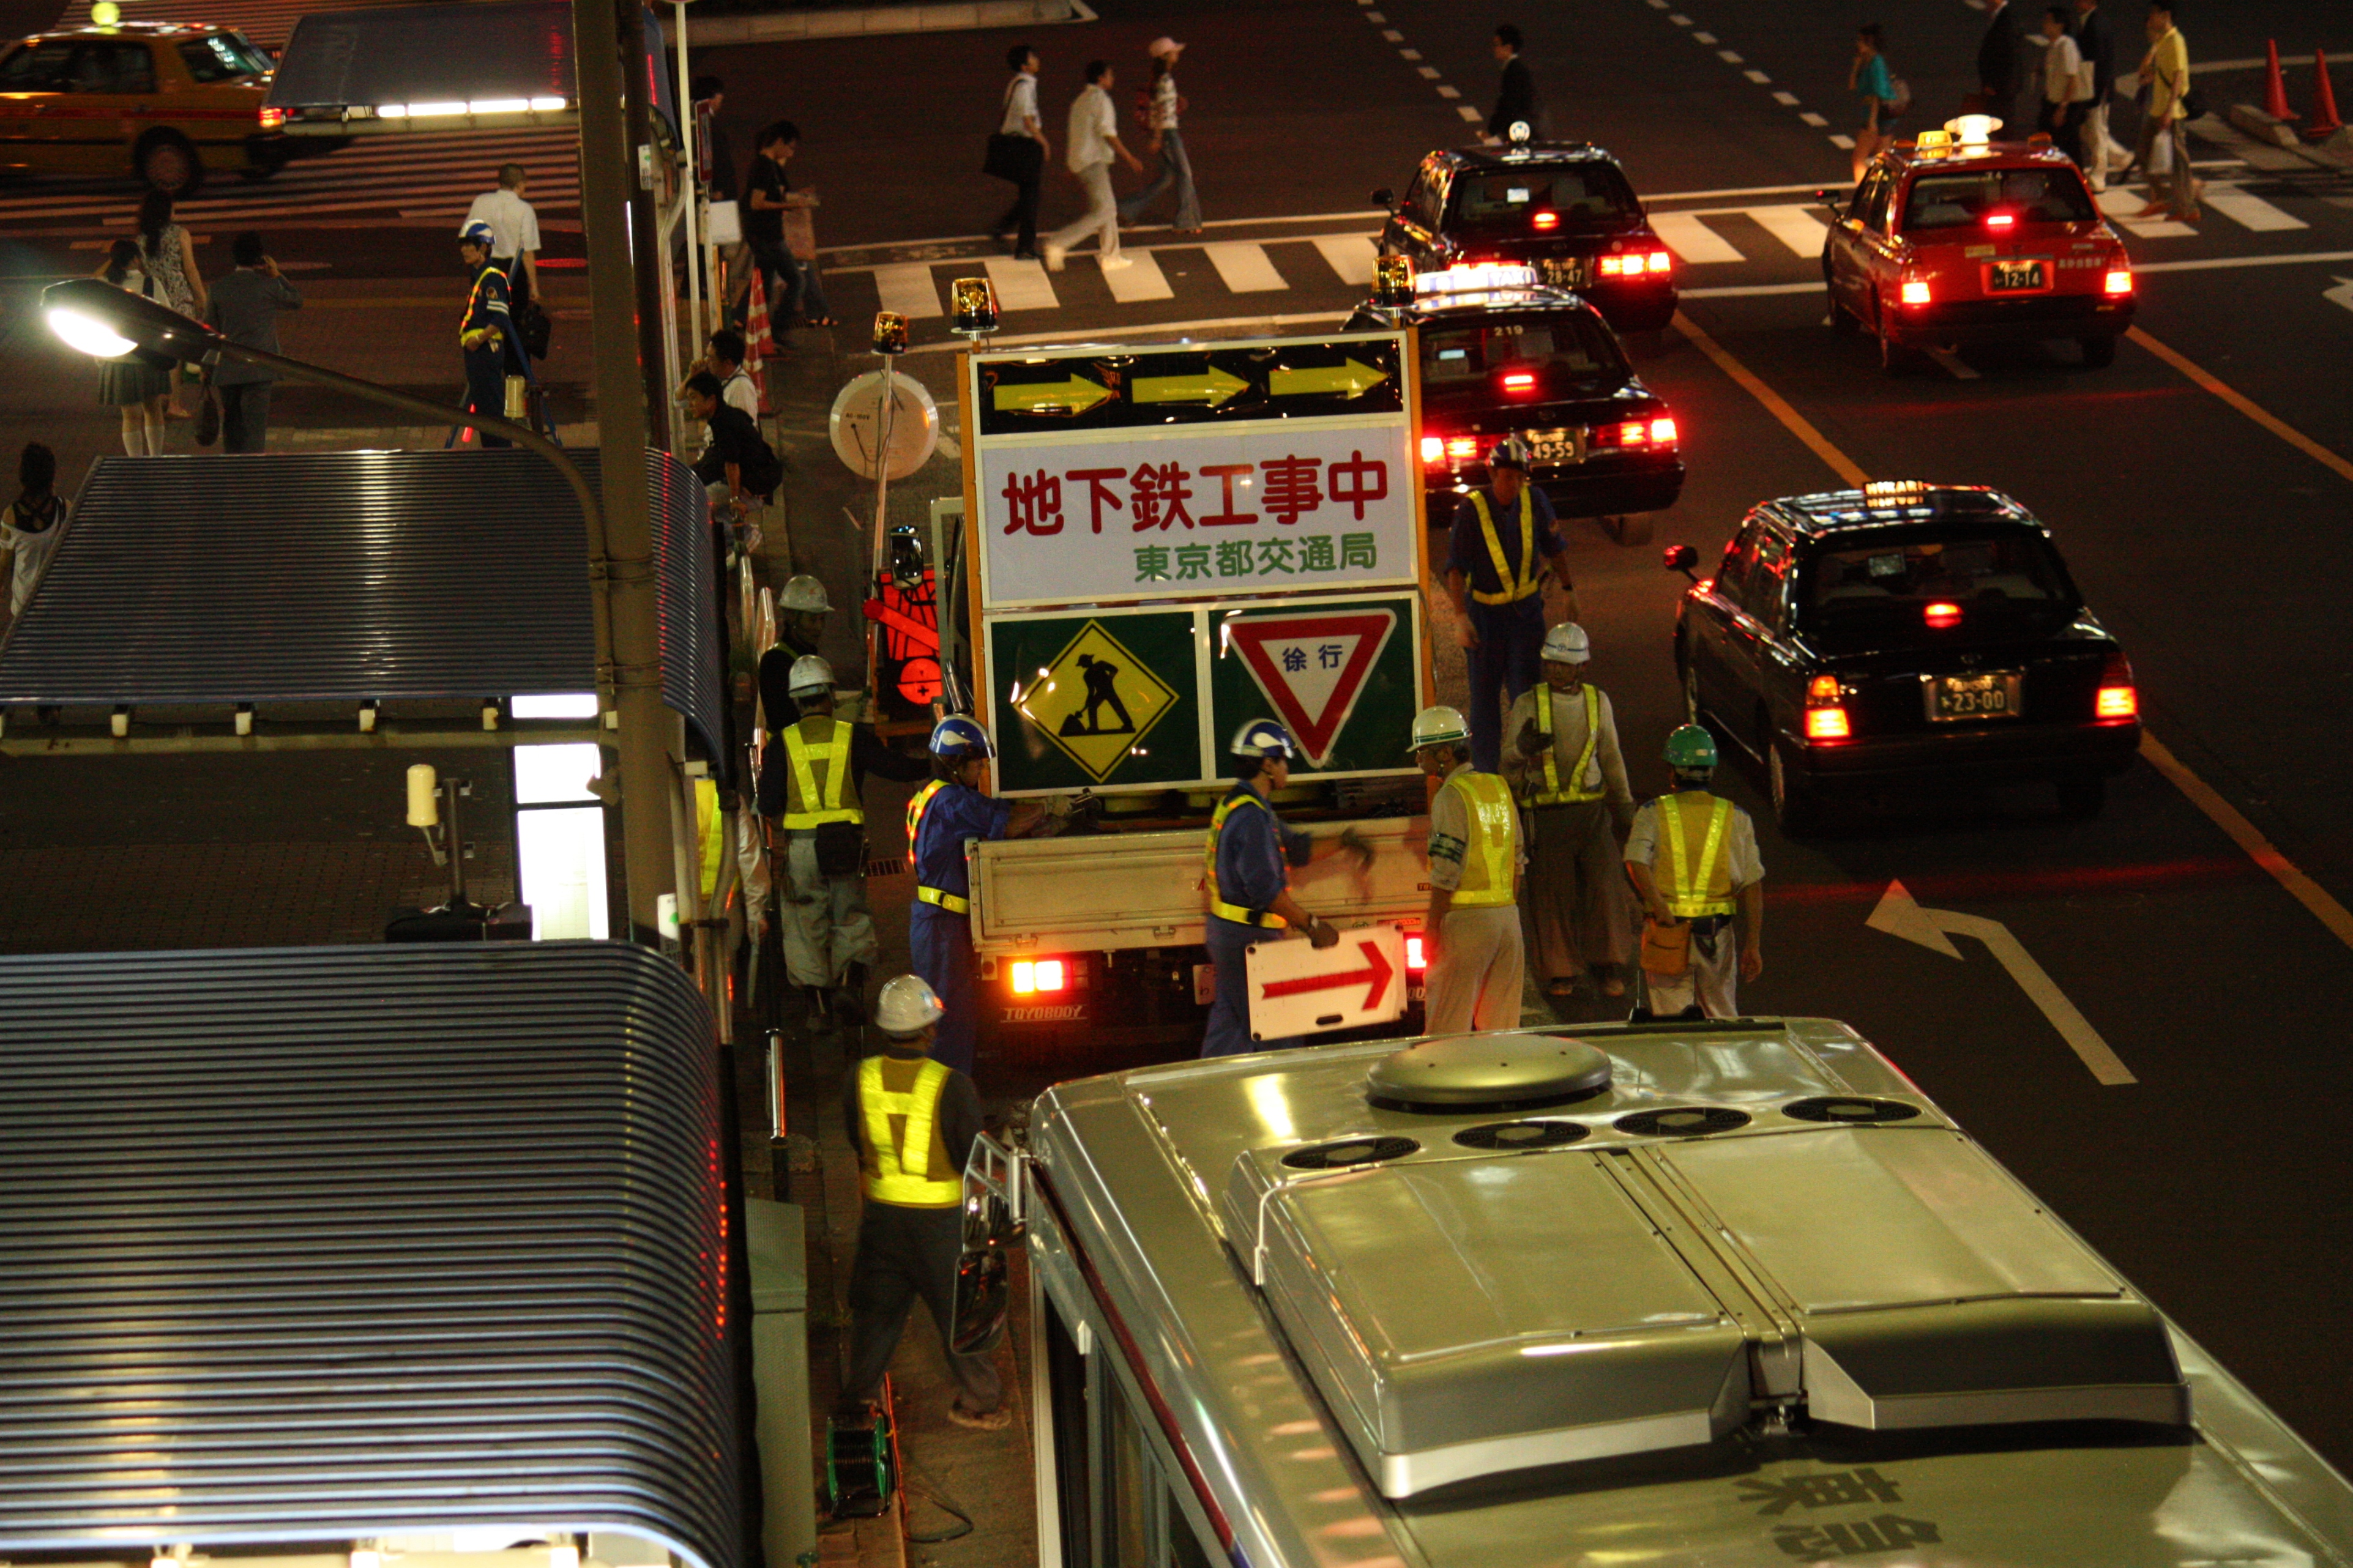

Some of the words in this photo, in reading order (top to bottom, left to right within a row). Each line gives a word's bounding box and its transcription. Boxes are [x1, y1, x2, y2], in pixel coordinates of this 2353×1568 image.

[1489, 270, 1531, 286] TAXI
[2005, 271, 2039, 286] 12-14
[1494, 325, 1523, 336] 219
[1533, 442, 1574, 458] 49-59
[1002, 450, 1388, 536] 地下鉄工事中
[1133, 532, 1377, 582] 東京都交通局
[1282, 644, 1343, 672] 徐行
[1953, 691, 2004, 712] 23-00
[1004, 1005, 1084, 1020] TOYOBODY
